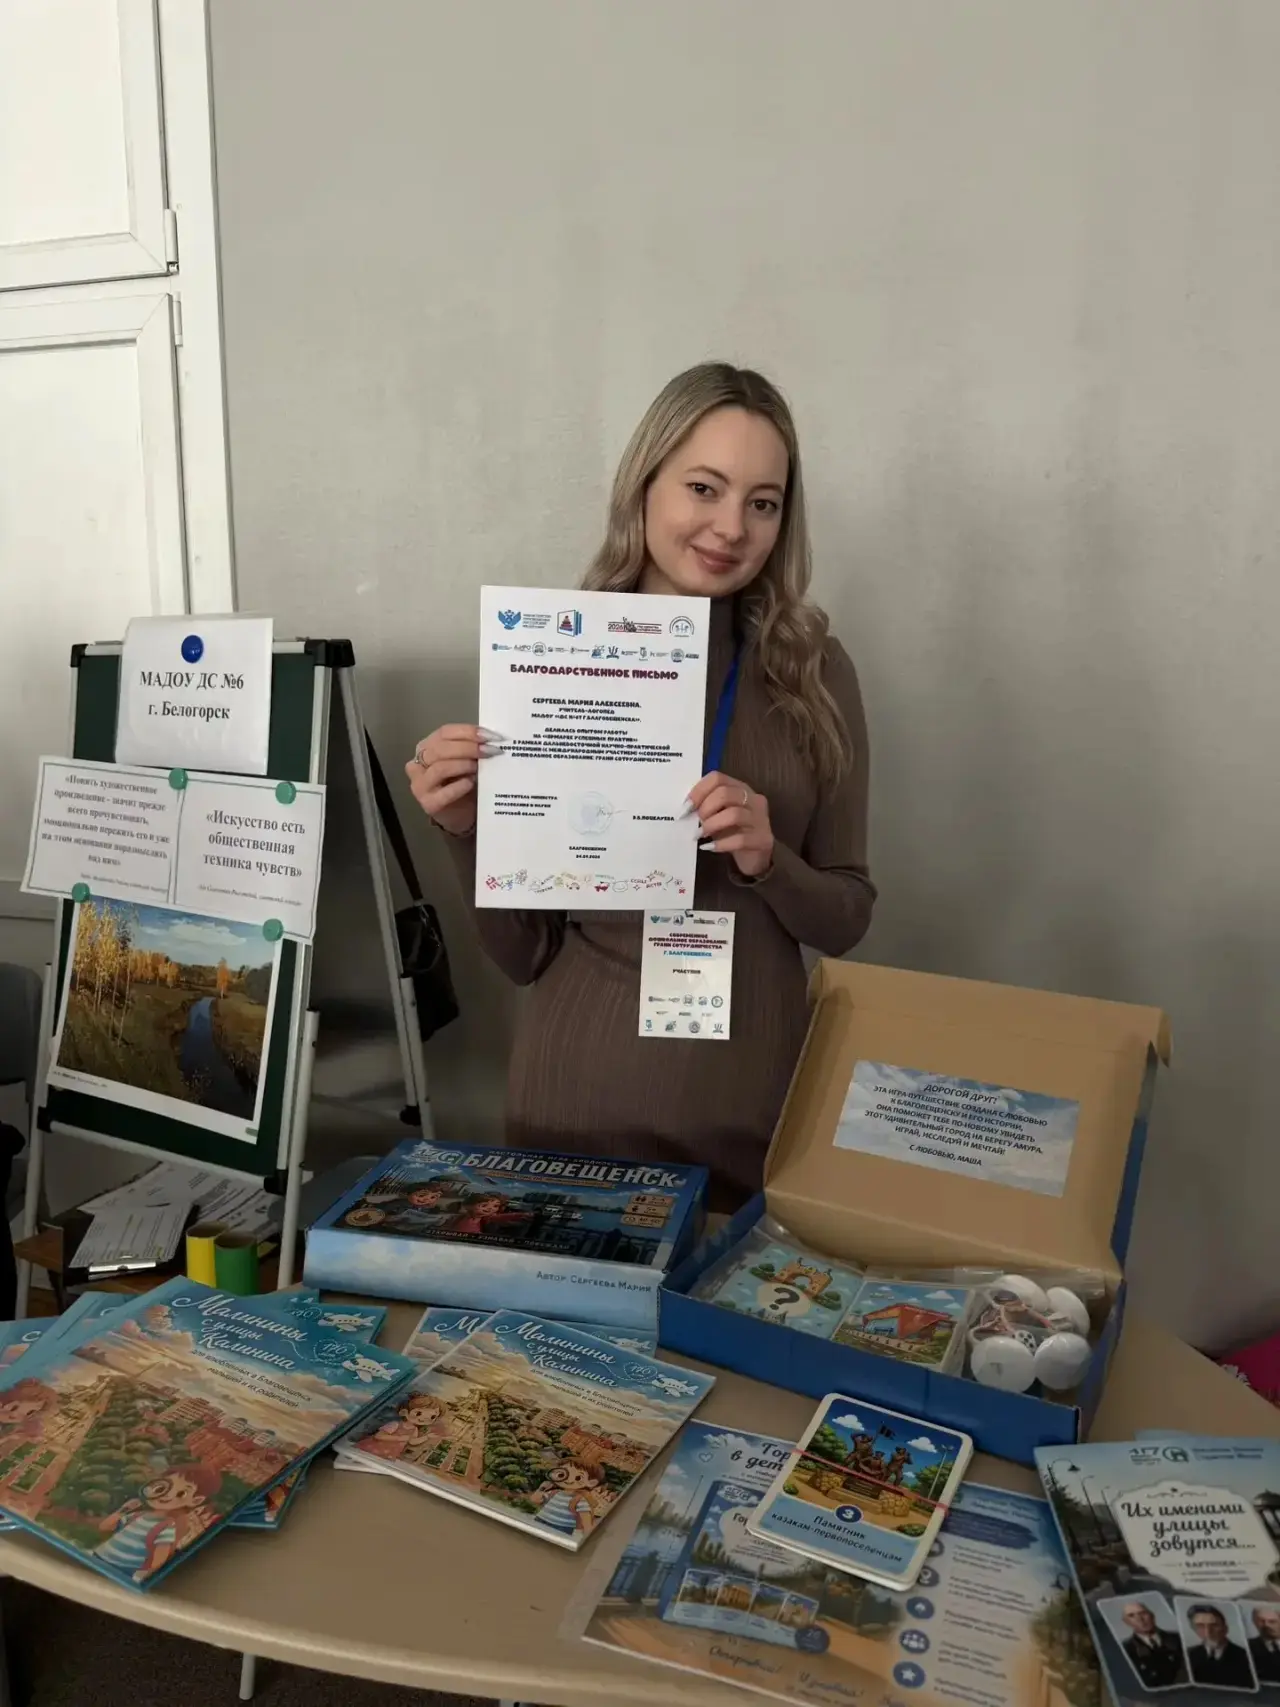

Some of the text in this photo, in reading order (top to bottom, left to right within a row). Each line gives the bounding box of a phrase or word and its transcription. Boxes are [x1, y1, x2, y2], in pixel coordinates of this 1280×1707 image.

[139, 671, 244, 690] МАДОУ ДС №6
[510, 664, 678, 680] БЛАГОДАРСТВЕННОЕ ПИСЬМО
[148, 701, 231, 722] г. Белогорск
[65, 774, 158, 795] «Понять художественное
[54, 789, 166, 811] произведение значит прежде
[67, 806, 88, 815] всего
[44, 818, 99, 832] эмоционально
[99, 826, 134, 838] пережить
[155, 835, 170, 844] уже
[206, 809, 305, 834] «Искусство есть
[54, 834, 72, 843] этом
[73, 837, 113, 850] основании
[113, 844, 168, 859] поразмыслить
[208, 832, 295, 855] общественная
[88, 854, 101, 864] над
[203, 853, 303, 877] техника чувств»
[873, 1085, 887, 1093] ЭТА
[961, 1103, 997, 1116] СОЗДАНА
[1004, 1112, 1048, 1127] ЛЮБОВЬЮ
[923, 1084, 997, 1104] ДОРОГОЙ ДРУГ!
[876, 1103, 1036, 1143] ОНА ПОМОЖЕТ ТЕБЕ ПО-НОВОМУ УВИДЕТЬ
[897, 1098, 961, 1117] БЛАГОВЕЩЕНСКУ
[968, 1113, 984, 1122] ЕГО
[984, 1118, 1023, 1132] ИСТОРИИ,
[864, 1110, 882, 1119] ЭТОТ
[884, 1114, 944, 1132] УДИВИТЕЛЬНЫЙ
[945, 1127, 971, 1139] ГОРОД
[984, 1135, 1012, 1146] БЕРЕГУ
[895, 1125, 921, 1138] ИГРАЙ,
[922, 1131, 962, 1145] ИССЛЕДУЙ
[970, 1142, 1005, 1155] МЕЧТАЙ!
[915, 1146, 956, 1161] ЛЮБОВЬЮ,
[957, 1155, 982, 1166] МАША
[462, 1153, 679, 1188] БЛАГОВЕЩЕНСК
[171, 1294, 309, 1342] Малинины
[201, 1318, 265, 1341] с улицы
[199, 1332, 296, 1370] Калинина
[495, 1321, 617, 1364] Малинины
[529, 1344, 581, 1362] улицы
[532, 1354, 618, 1387] Калинина
[207, 1367, 242, 1384] малышей
[247, 1384, 257, 1392] их
[255, 1387, 300, 1408] родителей
[841, 1508, 855, 1519] 3
[1121, 1502, 1246, 1518] Их именами
[771, 1513, 904, 1562] казакам-первопоселенцам
[813, 1515, 867, 1540] Памятник
[1152, 1519, 1230, 1539] улицы
